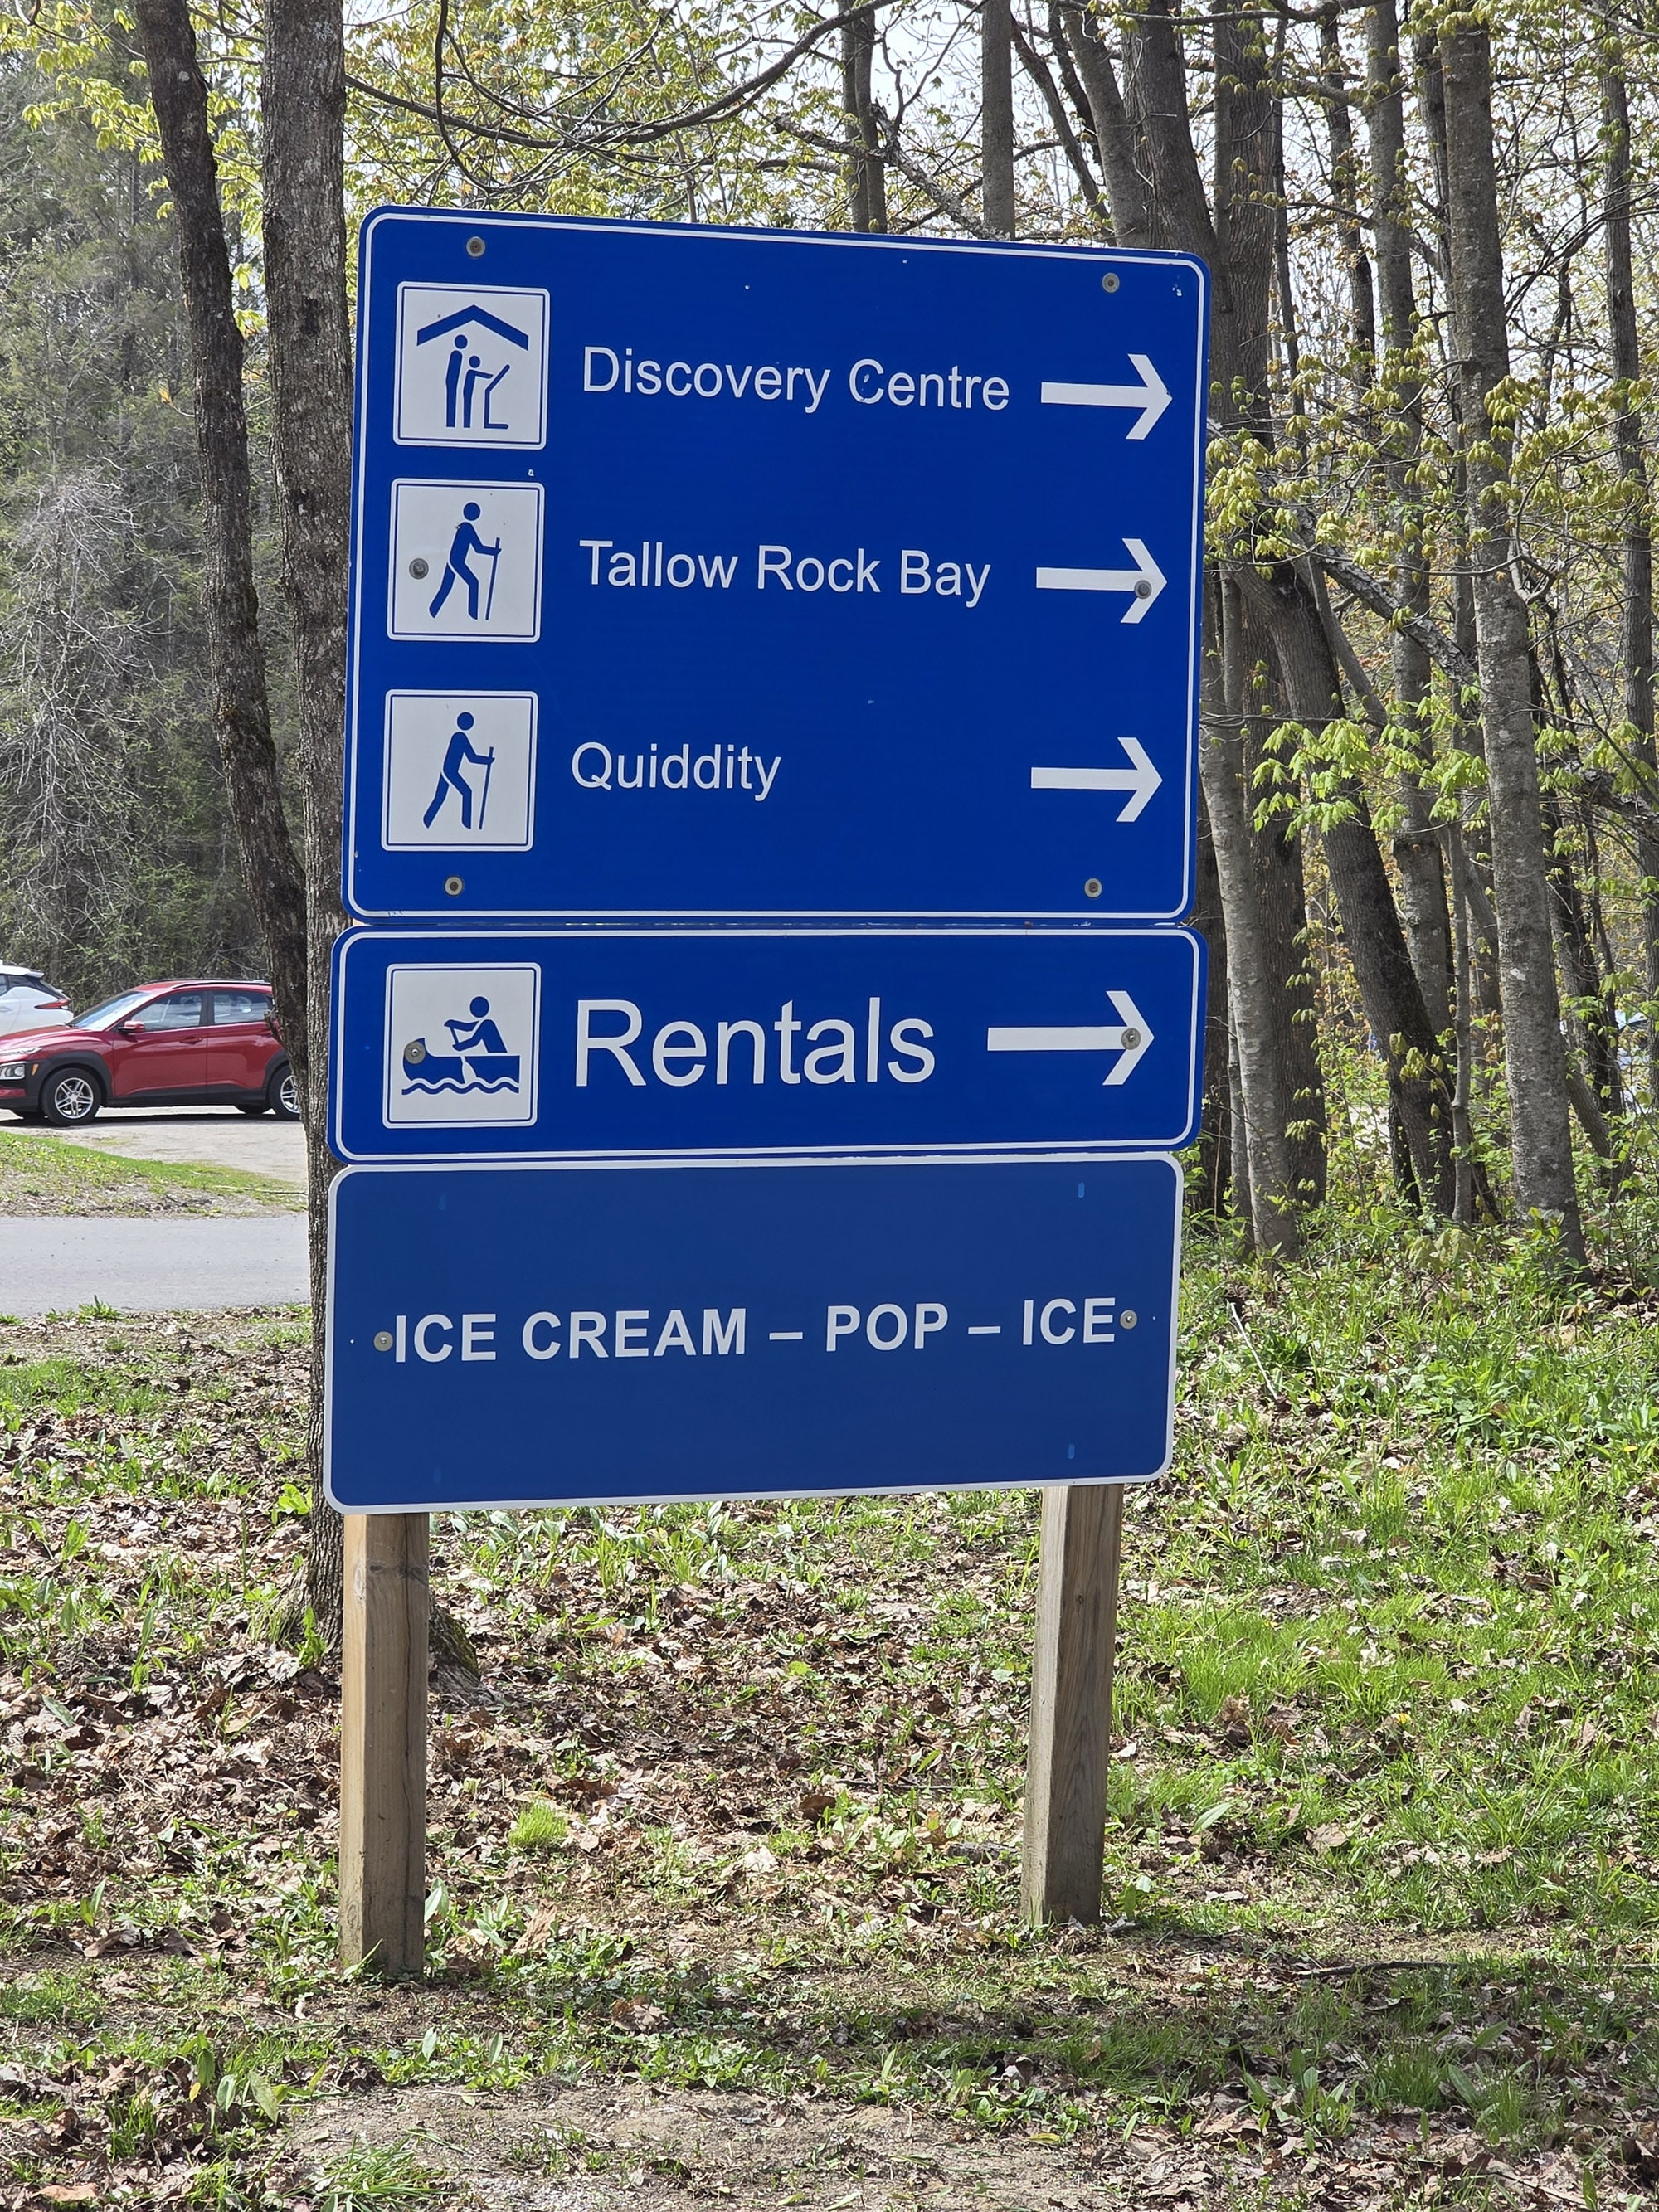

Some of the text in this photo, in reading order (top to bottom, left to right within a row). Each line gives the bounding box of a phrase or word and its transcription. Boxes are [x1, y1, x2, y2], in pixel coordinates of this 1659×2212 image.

[583, 346, 1010, 414] Discovery Centre
[579, 540, 991, 608] Tallow Rock Bay
[572, 741, 781, 802] Quiddity
[576, 997, 935, 1087] Rentals
[396, 1313, 496, 1363] ICE
[522, 1308, 746, 1360] CREAM
[826, 1303, 948, 1352] POP
[1023, 1297, 1117, 1345] ICE
